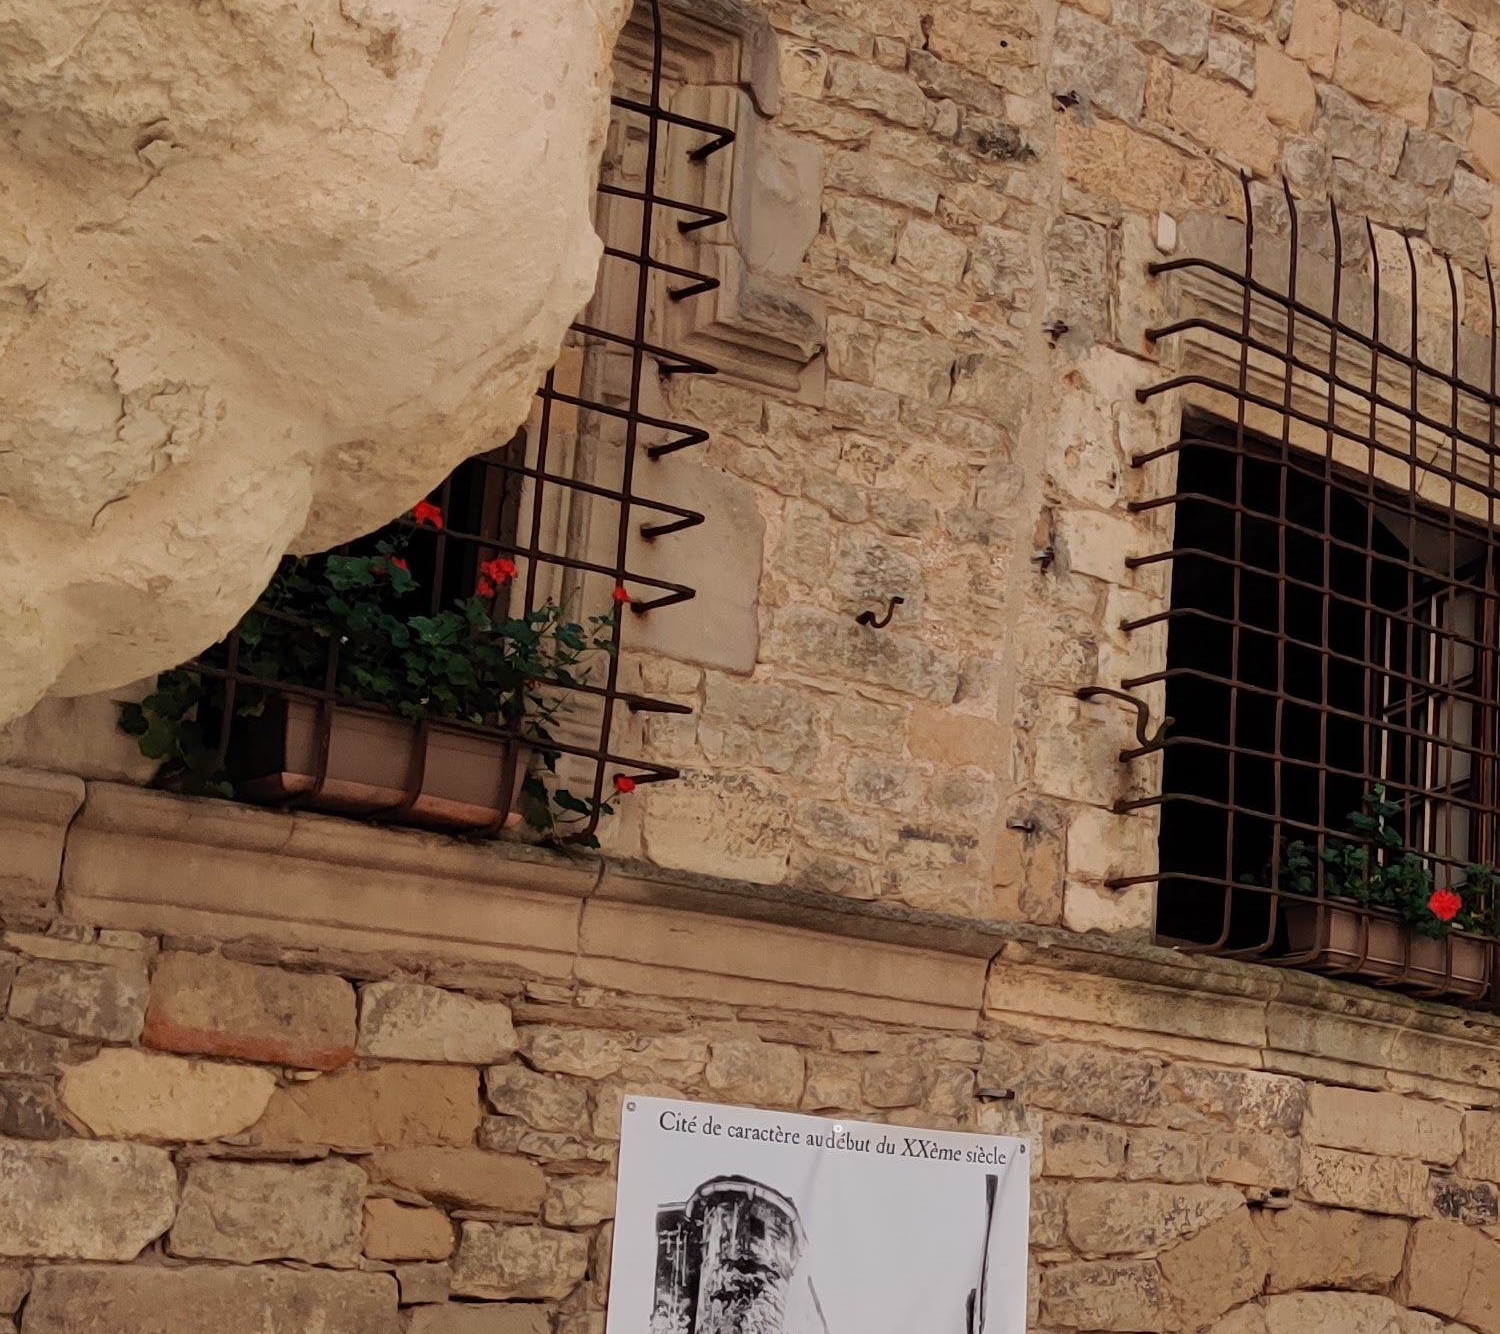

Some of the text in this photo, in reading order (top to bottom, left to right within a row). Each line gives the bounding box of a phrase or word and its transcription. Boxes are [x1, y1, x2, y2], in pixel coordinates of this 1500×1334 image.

[659, 1110, 1007, 1165] Cité de caractère au début du XXème siècle
